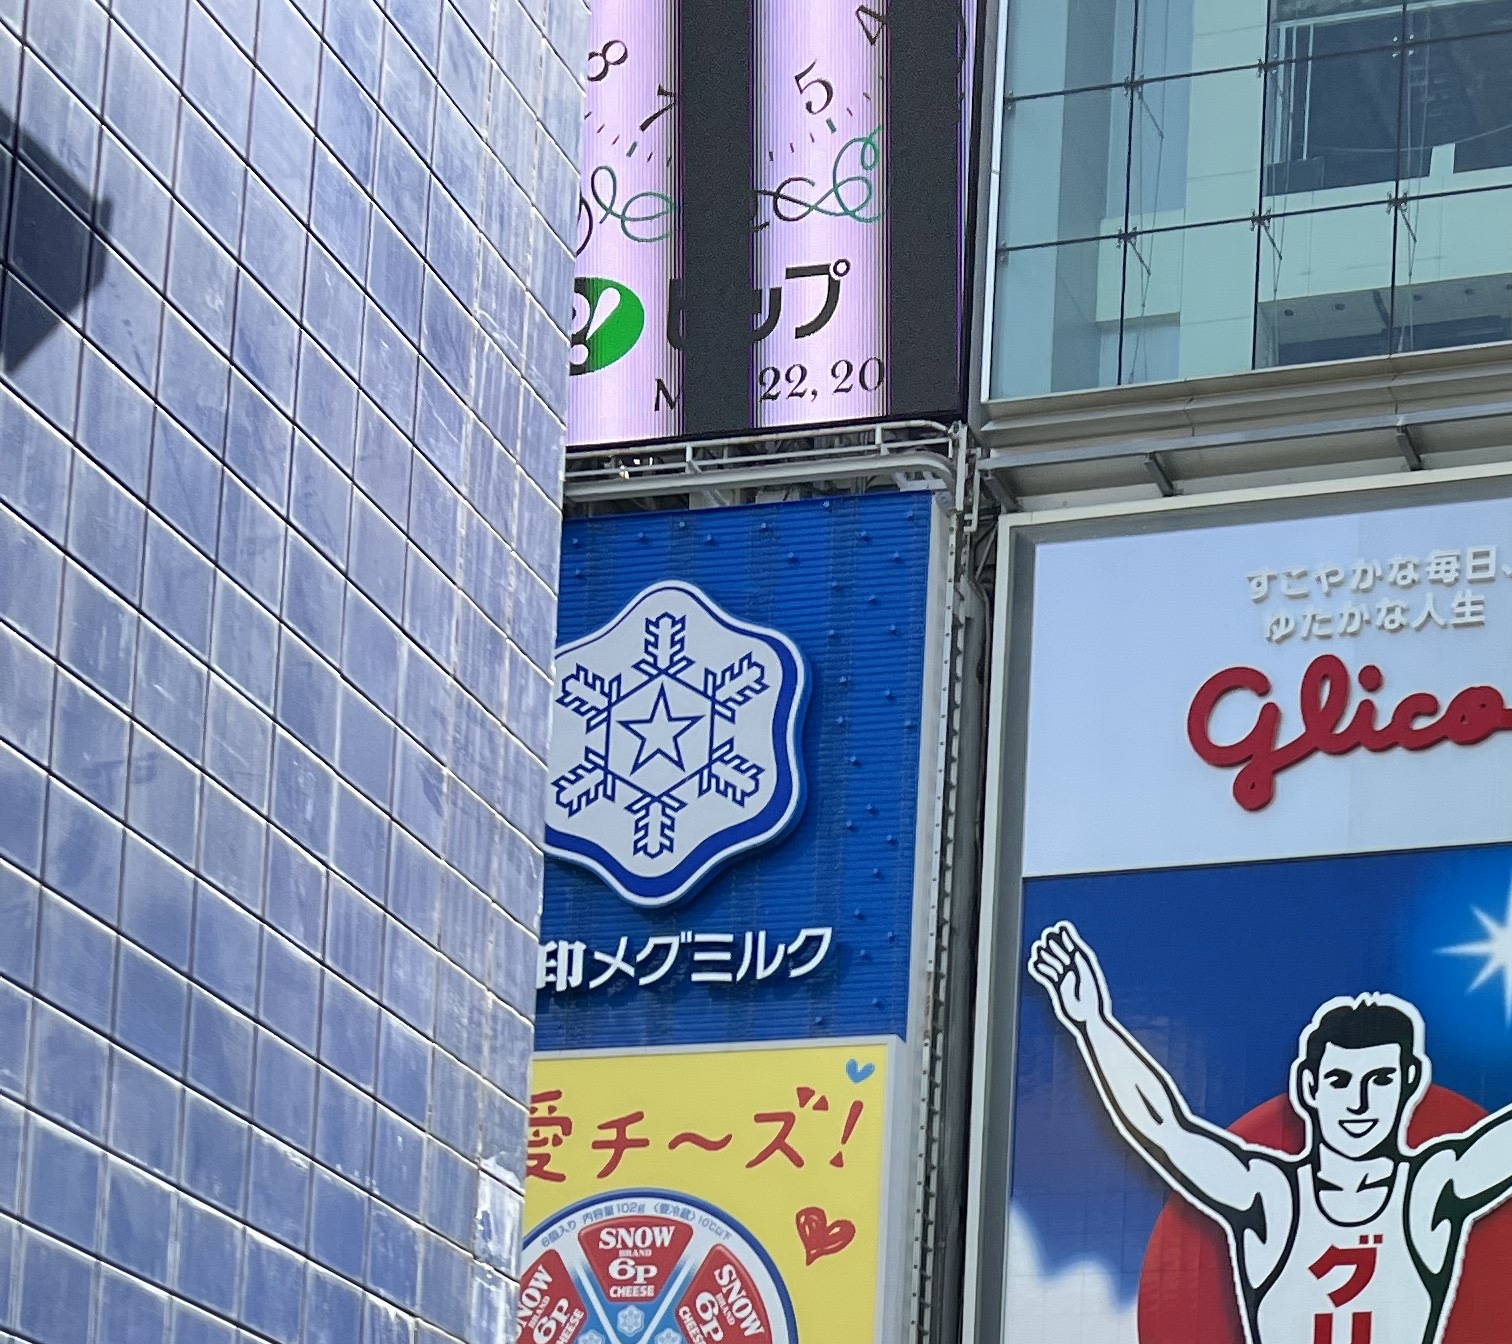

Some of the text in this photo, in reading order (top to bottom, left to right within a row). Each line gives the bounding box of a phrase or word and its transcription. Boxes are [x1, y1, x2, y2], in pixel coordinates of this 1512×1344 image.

[795, 59, 833, 115] 5
[1264, 589, 1487, 643] ゆたかな人生
[535, 927, 832, 992] 印メグミルク
[599, 1225, 676, 1250] SNOW
[608, 1258, 658, 1285] 6P
[609, 1285, 655, 1298] CHEESE
[533, 1298, 570, 1344] 6P
[695, 1291, 724, 1342] 6P
[714, 1264, 765, 1337] SNOW
